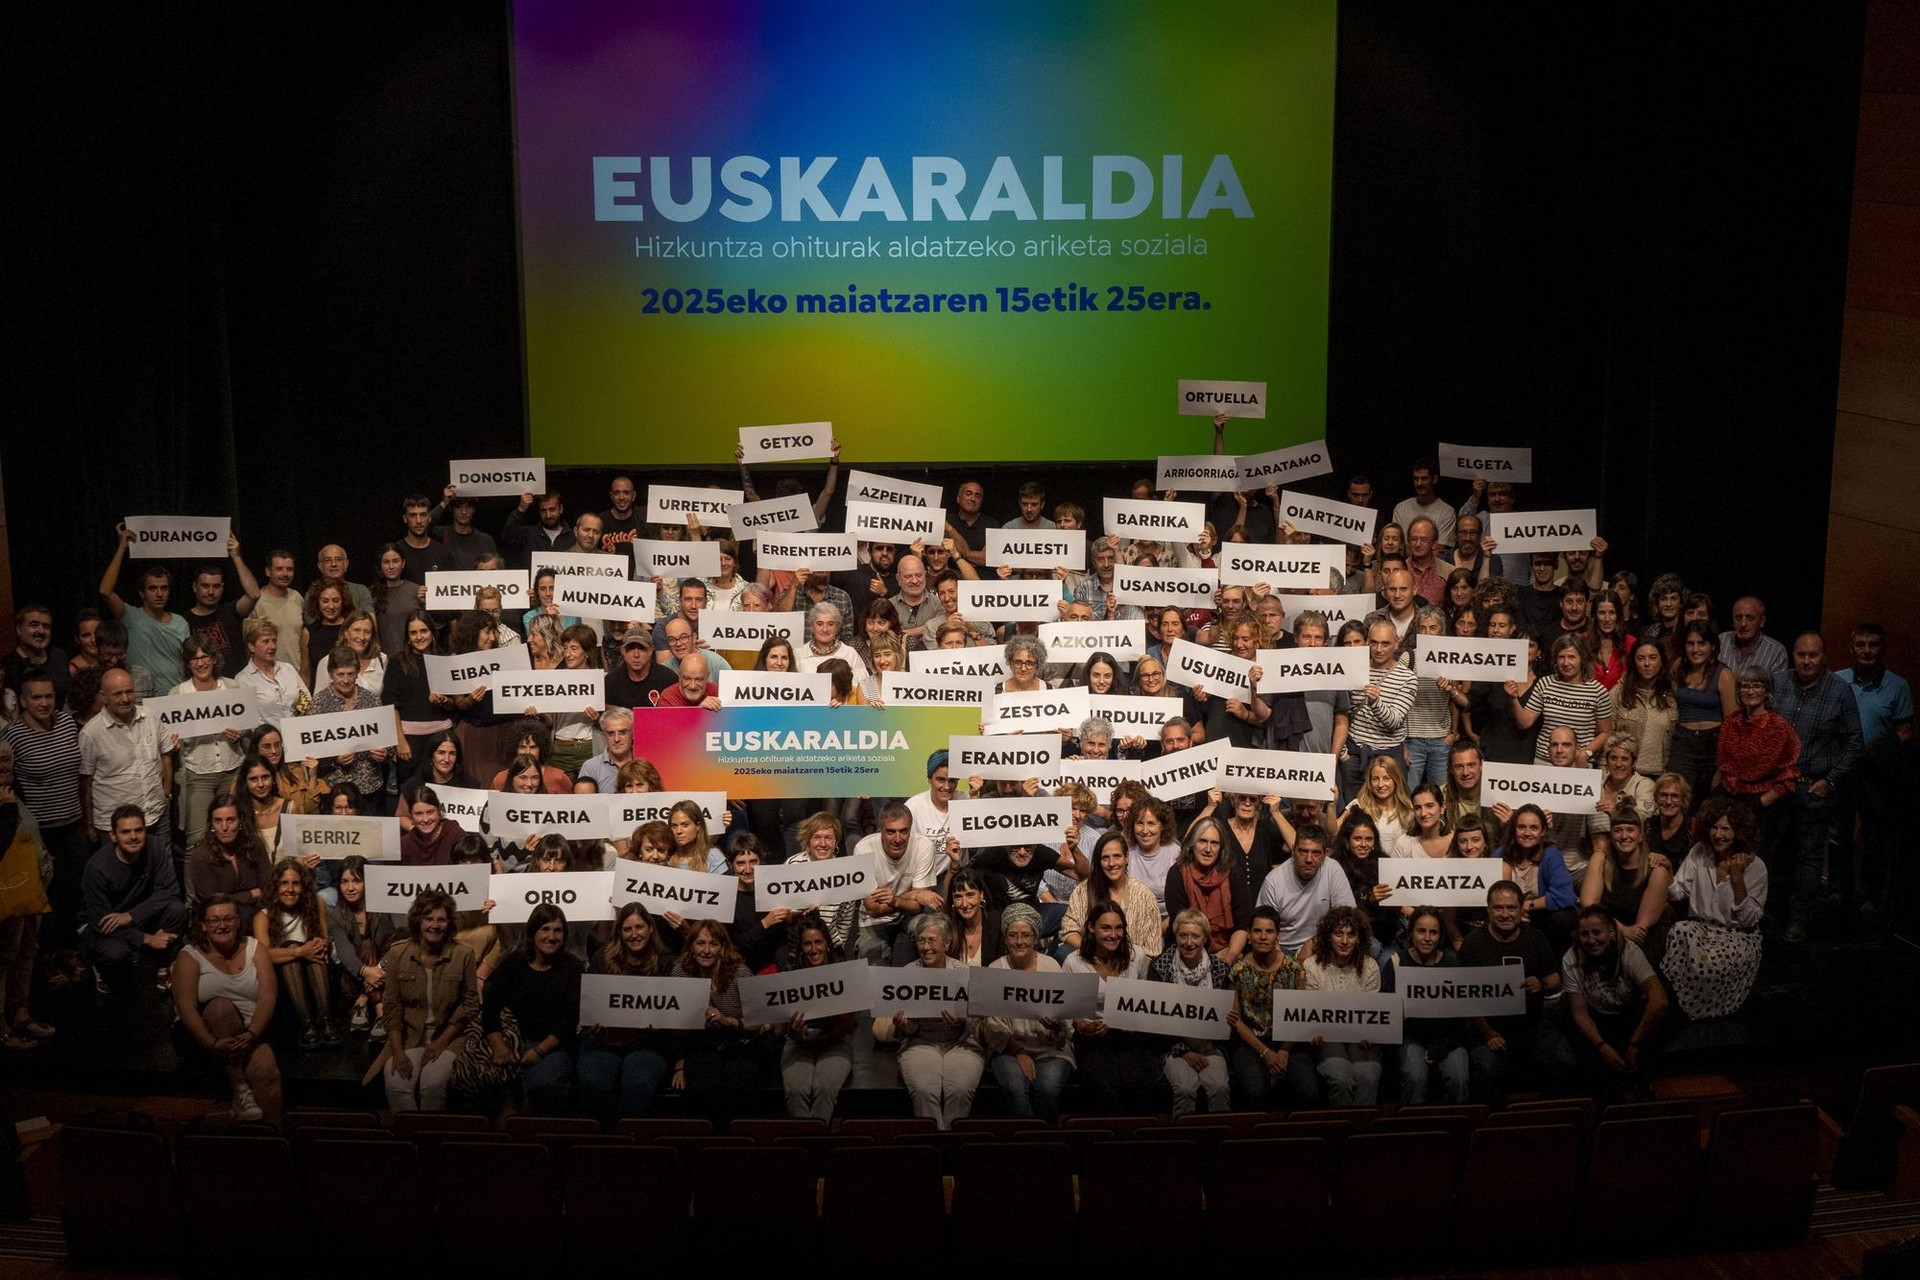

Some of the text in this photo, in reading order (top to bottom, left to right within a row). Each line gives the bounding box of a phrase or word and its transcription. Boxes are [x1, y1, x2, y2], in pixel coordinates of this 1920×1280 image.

[593, 154, 1255, 223] EUSKARALDIA
[635, 233, 1209, 259] Hizkuntza ohiturak aldatzeko ariketa soziala
[641, 282, 1212, 315] 2025eko maiatzaren 15etik 25era.
[1185, 391, 1259, 405] ORTUELLA
[759, 435, 814, 450] GETXO
[1244, 453, 1322, 478] ZARATAMO
[1457, 457, 1513, 471] ELGETA
[459, 471, 537, 484] DONOSTIA
[859, 486, 927, 507] AZPEITIA
[742, 508, 800, 527] GASTEIZ
[857, 515, 934, 533] HERNANI
[1116, 512, 1189, 529] BARRIKA
[1286, 505, 1366, 533] OIARTZUN
[139, 530, 218, 543] DURANGO
[1504, 523, 1583, 539] LAUTADA
[762, 543, 852, 557] ERRENTERIA
[1002, 543, 1068, 556] AULESTI
[652, 554, 690, 567] IRUN
[1230, 558, 1321, 574] SORALUZE
[536, 564, 624, 578] MARRAGA
[435, 583, 520, 597] MENDRO
[1119, 579, 1212, 595] USANSOLO
[561, 589, 646, 609] MUNDAKA
[971, 594, 1050, 608] URDULIZ
[712, 624, 791, 640] ABADIÑO
[1051, 634, 1133, 649] AZKOITIA
[1425, 650, 1517, 667] ARRASATE
[450, 662, 501, 681] EIBAR
[1180, 655, 1250, 689] USURBIL
[1280, 662, 1345, 678] PASAIA
[501, 683, 595, 698] ETXEBARRI
[734, 686, 815, 702] MUNGIA
[892, 686, 983, 702] TXORIERRI
[160, 703, 246, 725] ARAMAIO
[999, 703, 1070, 719] ZESTOA
[301, 722, 379, 745] BEASAIN
[705, 730, 910, 752] EUSKARALDIA
[717, 753, 896, 764] Hizkuntza ohiturak aldatzeko ariketa soziala
[961, 750, 1050, 766] ERANDIO
[733, 765, 880, 775] 2025eko maiatzaren 15etik 25era
[1140, 757, 1218, 790] MUTRIKU
[1225, 764, 1326, 783] ETXEBARRIA
[1487, 778, 1595, 797] TOLOSALDEA
[506, 809, 591, 825] GETARIA
[622, 807, 713, 822] BERGA
[962, 813, 1060, 831] ELGOIBAR
[302, 829, 361, 846] BERRIZ
[387, 881, 469, 898] ZUMAIA
[766, 870, 866, 895] OTXANDIO
[1395, 875, 1486, 890] AREATZA
[524, 889, 577, 905] ORIO
[625, 878, 720, 906] ZARAUTZ
[765, 979, 845, 1007] ZIBURU
[882, 984, 969, 1002] SOPELA
[1003, 986, 1065, 1005] FRUIZ
[1406, 980, 1515, 1000] IRUÑERRIA
[608, 993, 681, 1011] ERMUA
[1116, 996, 1220, 1023] MALLABIA
[1283, 1007, 1391, 1026] MIARRITZE
